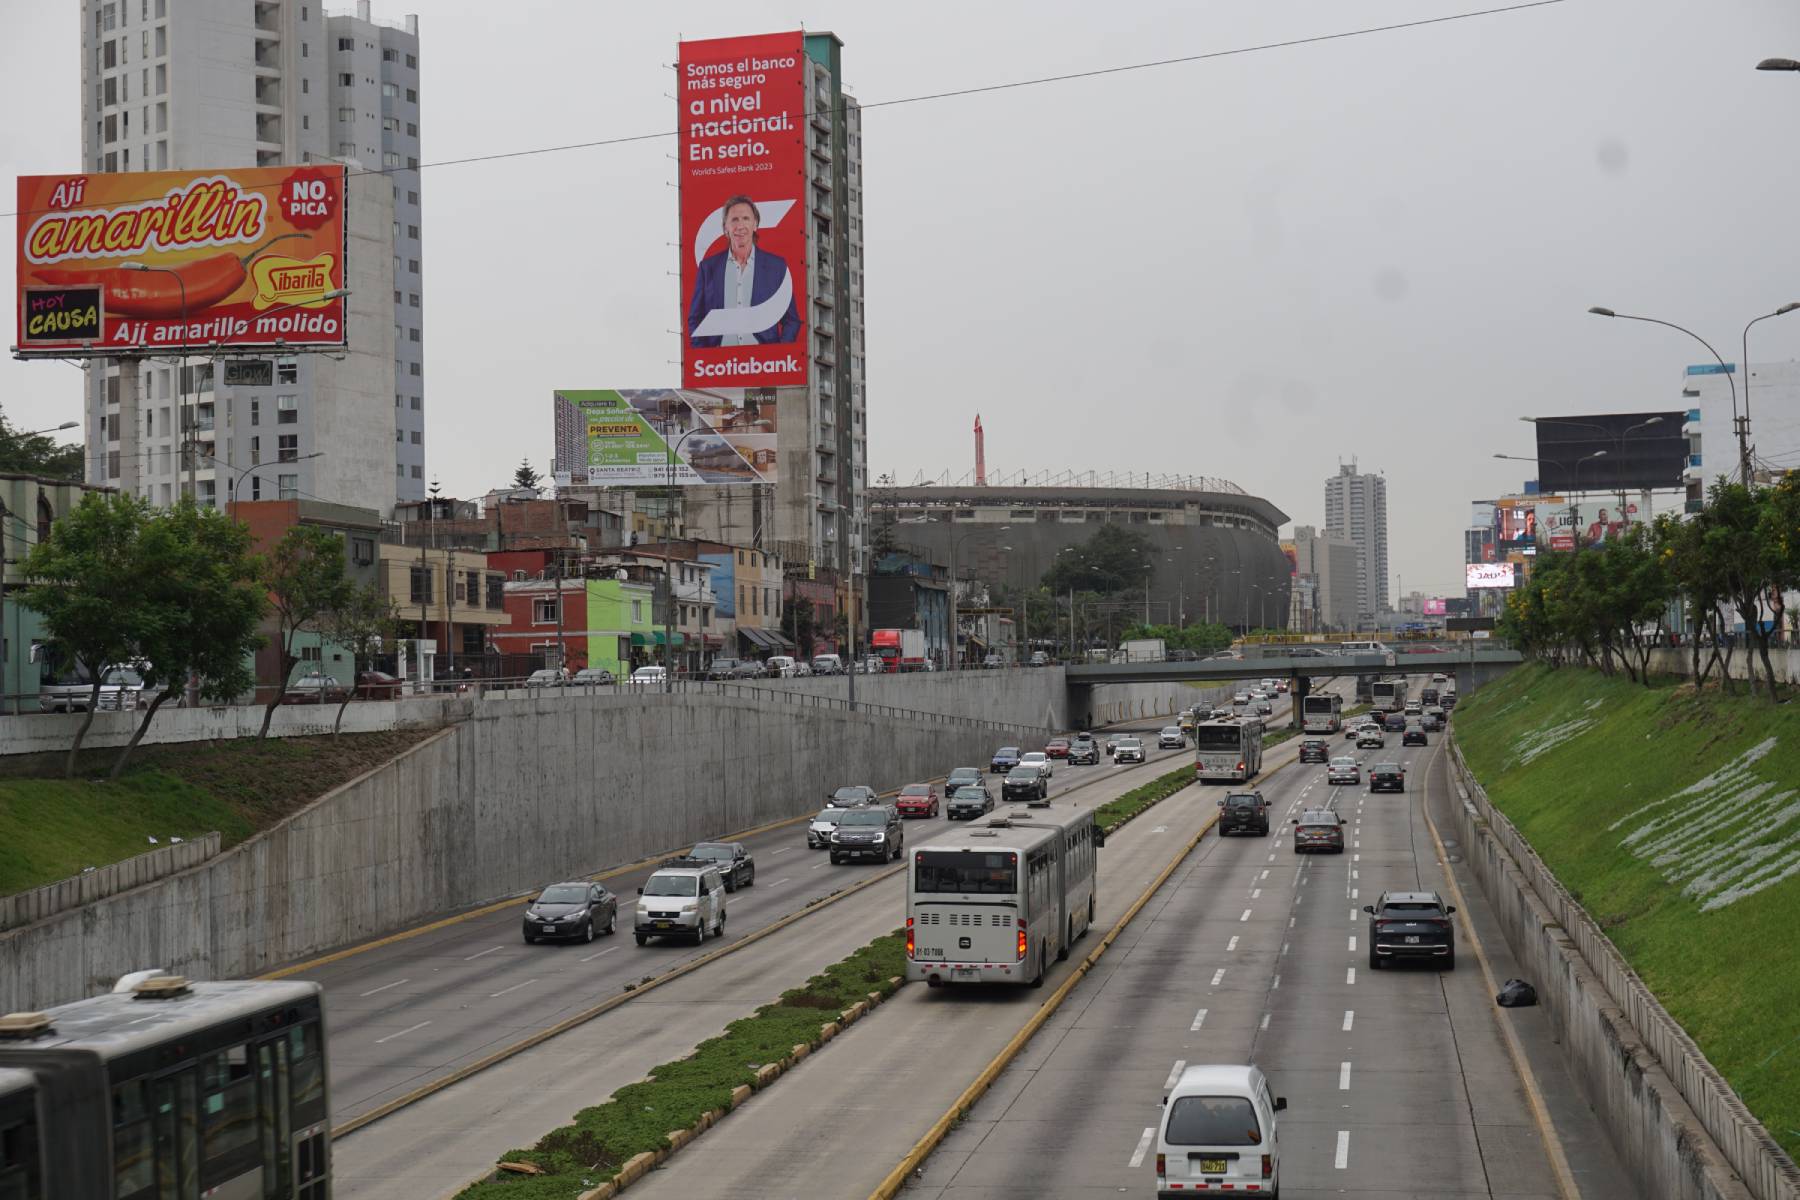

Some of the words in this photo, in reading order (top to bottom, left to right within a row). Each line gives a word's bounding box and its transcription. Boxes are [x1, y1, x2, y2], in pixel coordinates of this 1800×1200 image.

[687, 63, 733, 77] Somos
[737, 58, 748, 72] el
[752, 57, 795, 71] banco
[688, 76, 716, 90] más
[719, 74, 766, 89] seguro
[690, 100, 704, 115] a
[710, 91, 761, 114] nivel
[691, 111, 794, 138] nacional.
[690, 144, 713, 161] En
[718, 138, 770, 159] serio.
[738, 164, 753, 172] Bank
[50, 178, 85, 207] Ají
[292, 180, 327, 201] NO
[30, 178, 262, 259] amarillin
[290, 202, 328, 217] PICA
[32, 294, 65, 311] HOY
[29, 305, 97, 335] CAUSA
[113, 322, 148, 345] Ají
[153, 316, 248, 342] amarillo
[256, 313, 338, 335] molido
[589, 424, 640, 435] PREVENTA
